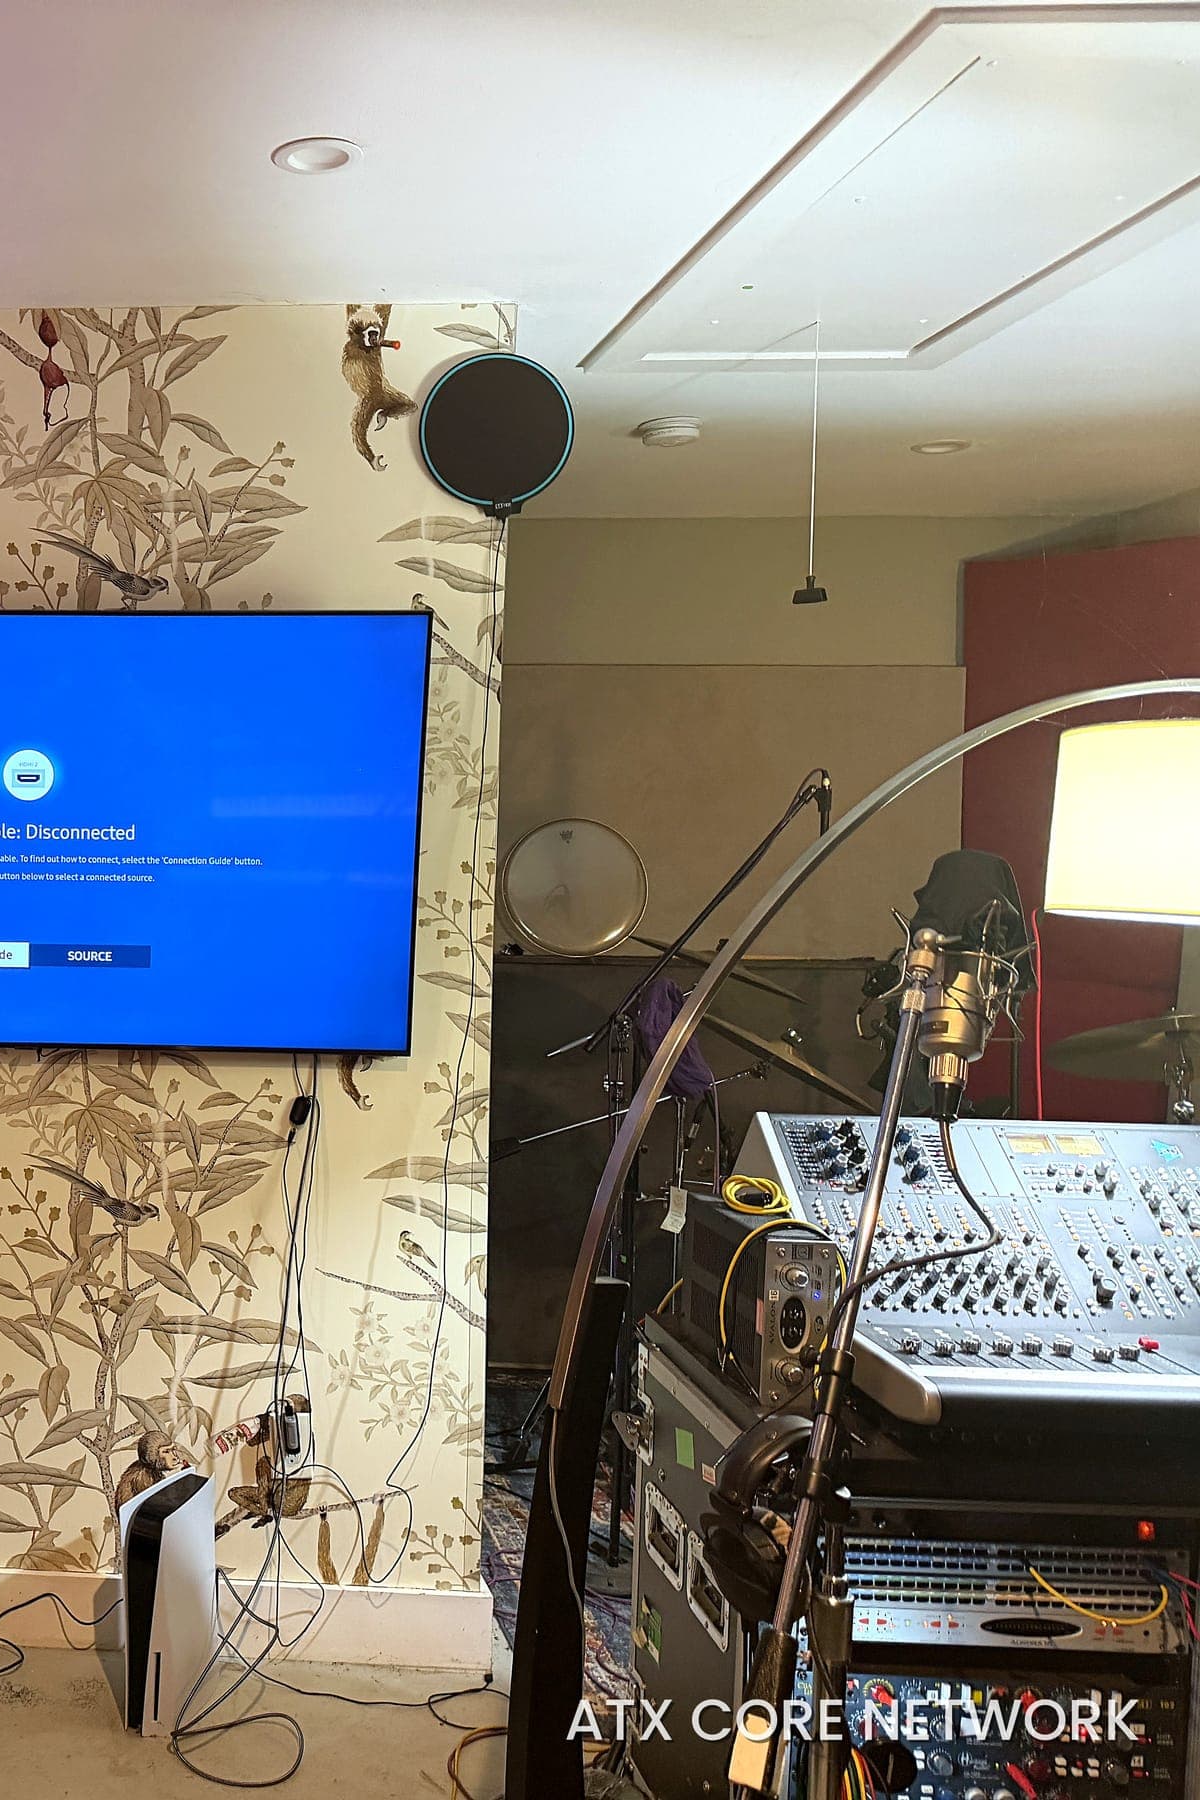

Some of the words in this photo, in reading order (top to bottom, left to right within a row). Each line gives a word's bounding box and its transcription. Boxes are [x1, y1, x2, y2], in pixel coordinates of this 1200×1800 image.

[26, 823, 136, 841] Disconnected
[20, 854, 29, 864] To
[30, 854, 45, 864] find
[47, 854, 60, 864] out
[61, 855, 78, 864] how
[79, 855, 87, 864] to
[88, 855, 120, 866] connect,
[122, 855, 145, 865] select
[147, 856, 160, 865] the
[162, 855, 207, 866] 'Connection
[209, 856, 233, 866] Guide'
[235, 856, 263, 867] button.
[21, 872, 45, 882] below
[45, 872, 54, 882] to
[55, 872, 78, 882] select
[80, 873, 85, 882] a
[86, 873, 126, 883] connected
[127, 874, 155, 883] source.
[67, 951, 113, 963] SOURCE
